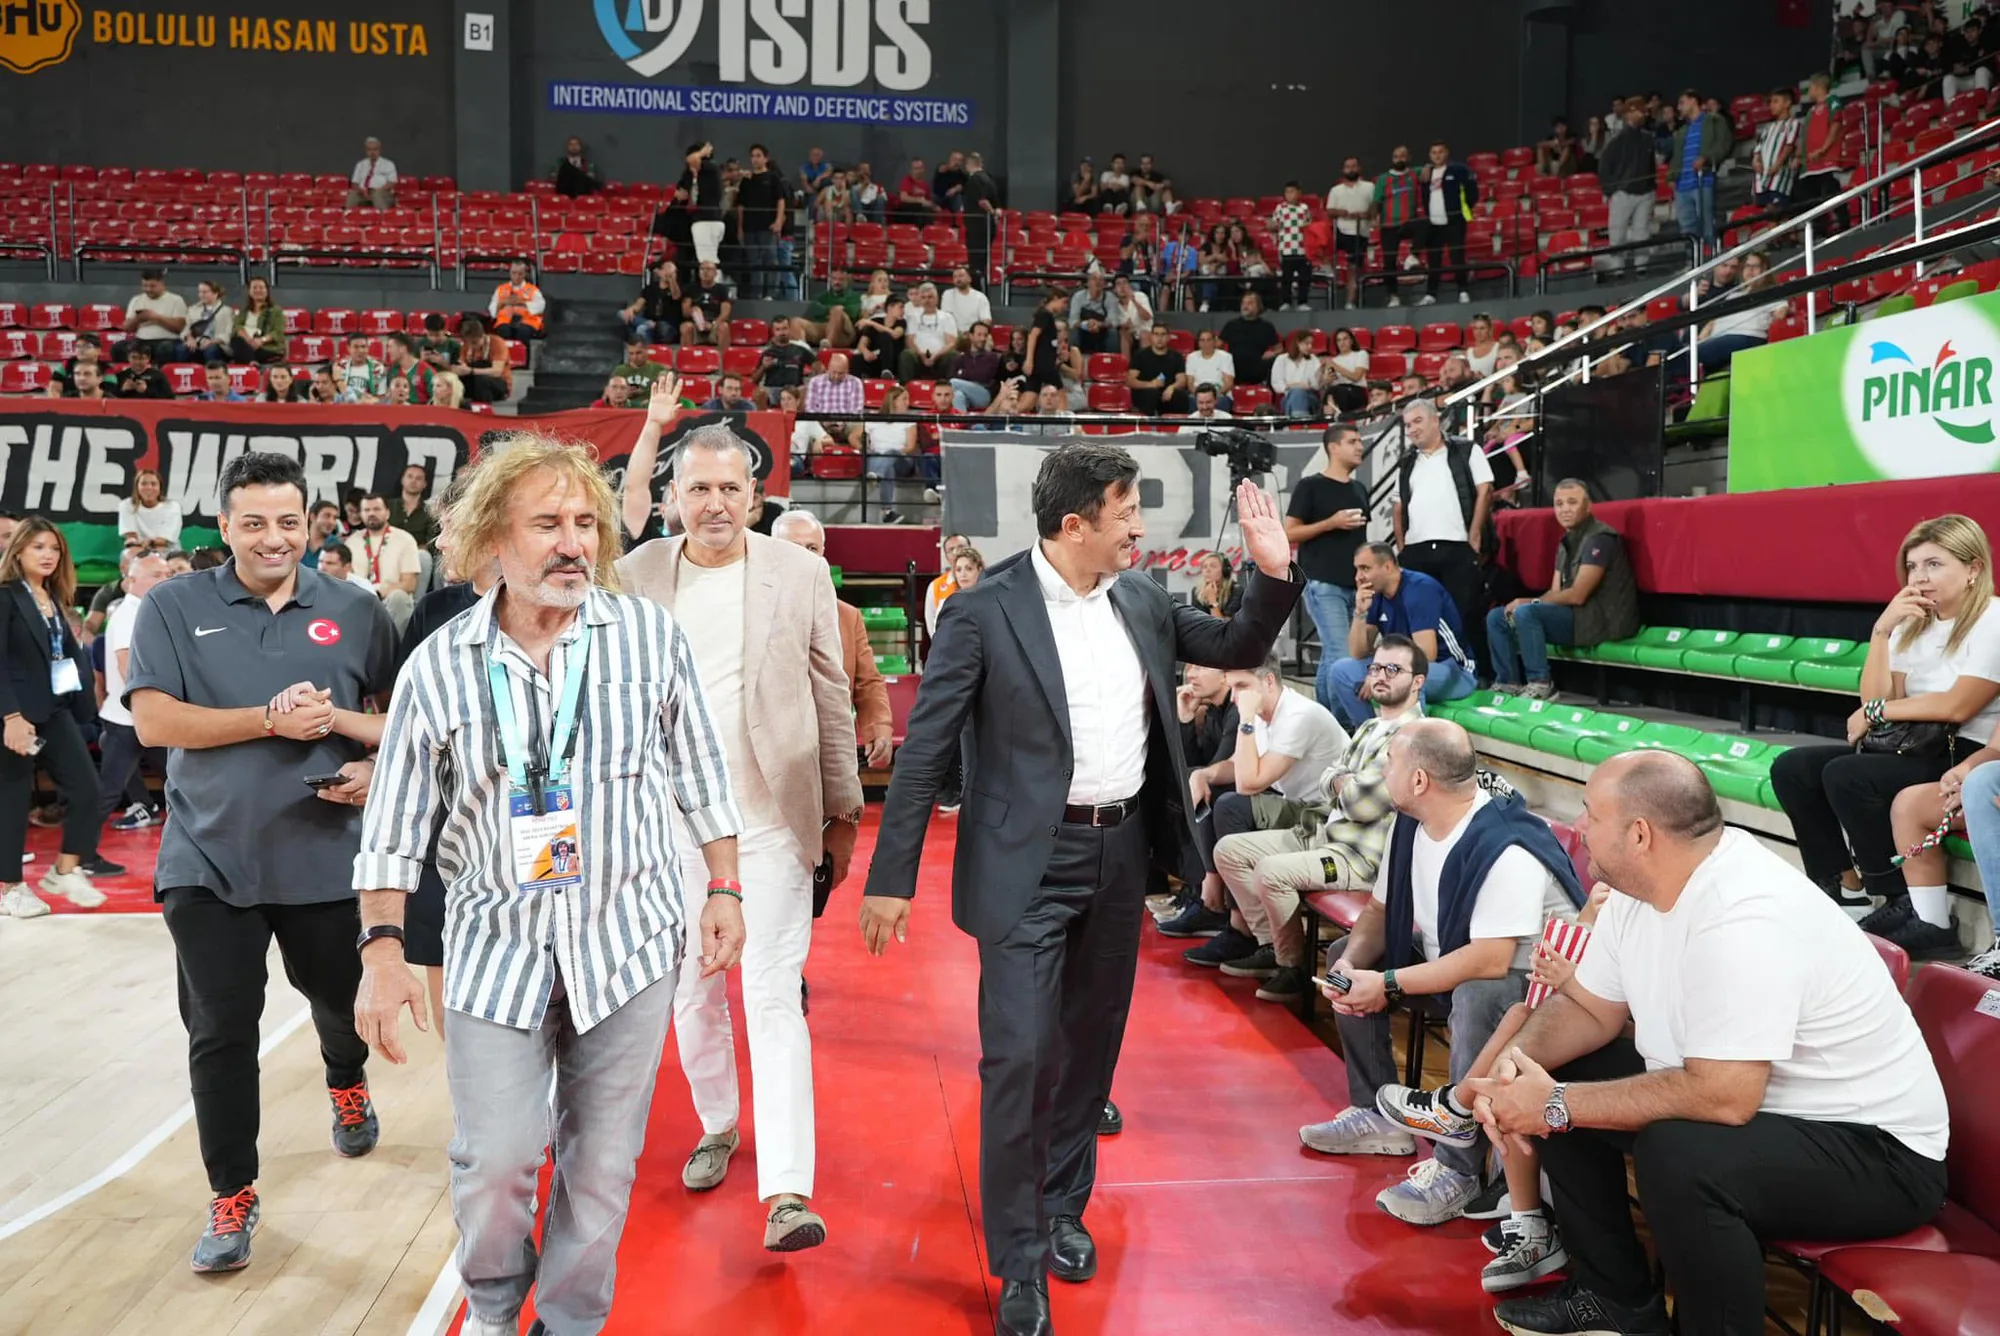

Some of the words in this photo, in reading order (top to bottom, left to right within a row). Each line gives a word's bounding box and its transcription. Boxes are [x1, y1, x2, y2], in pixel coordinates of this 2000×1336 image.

[0, 0, 62, 36] HU
[93, 10, 216, 48] BOLULU
[229, 16, 336, 53] HASAN
[350, 21, 428, 56] USTA
[469, 23, 491, 41] B1
[718, 0, 932, 91] ISDS
[553, 85, 686, 111] INTERNATIONAL
[690, 90, 771, 115] SECURITY
[774, 96, 810, 117] AND
[814, 97, 890, 120] DEFENCE
[893, 101, 968, 124] SYSTEMS
